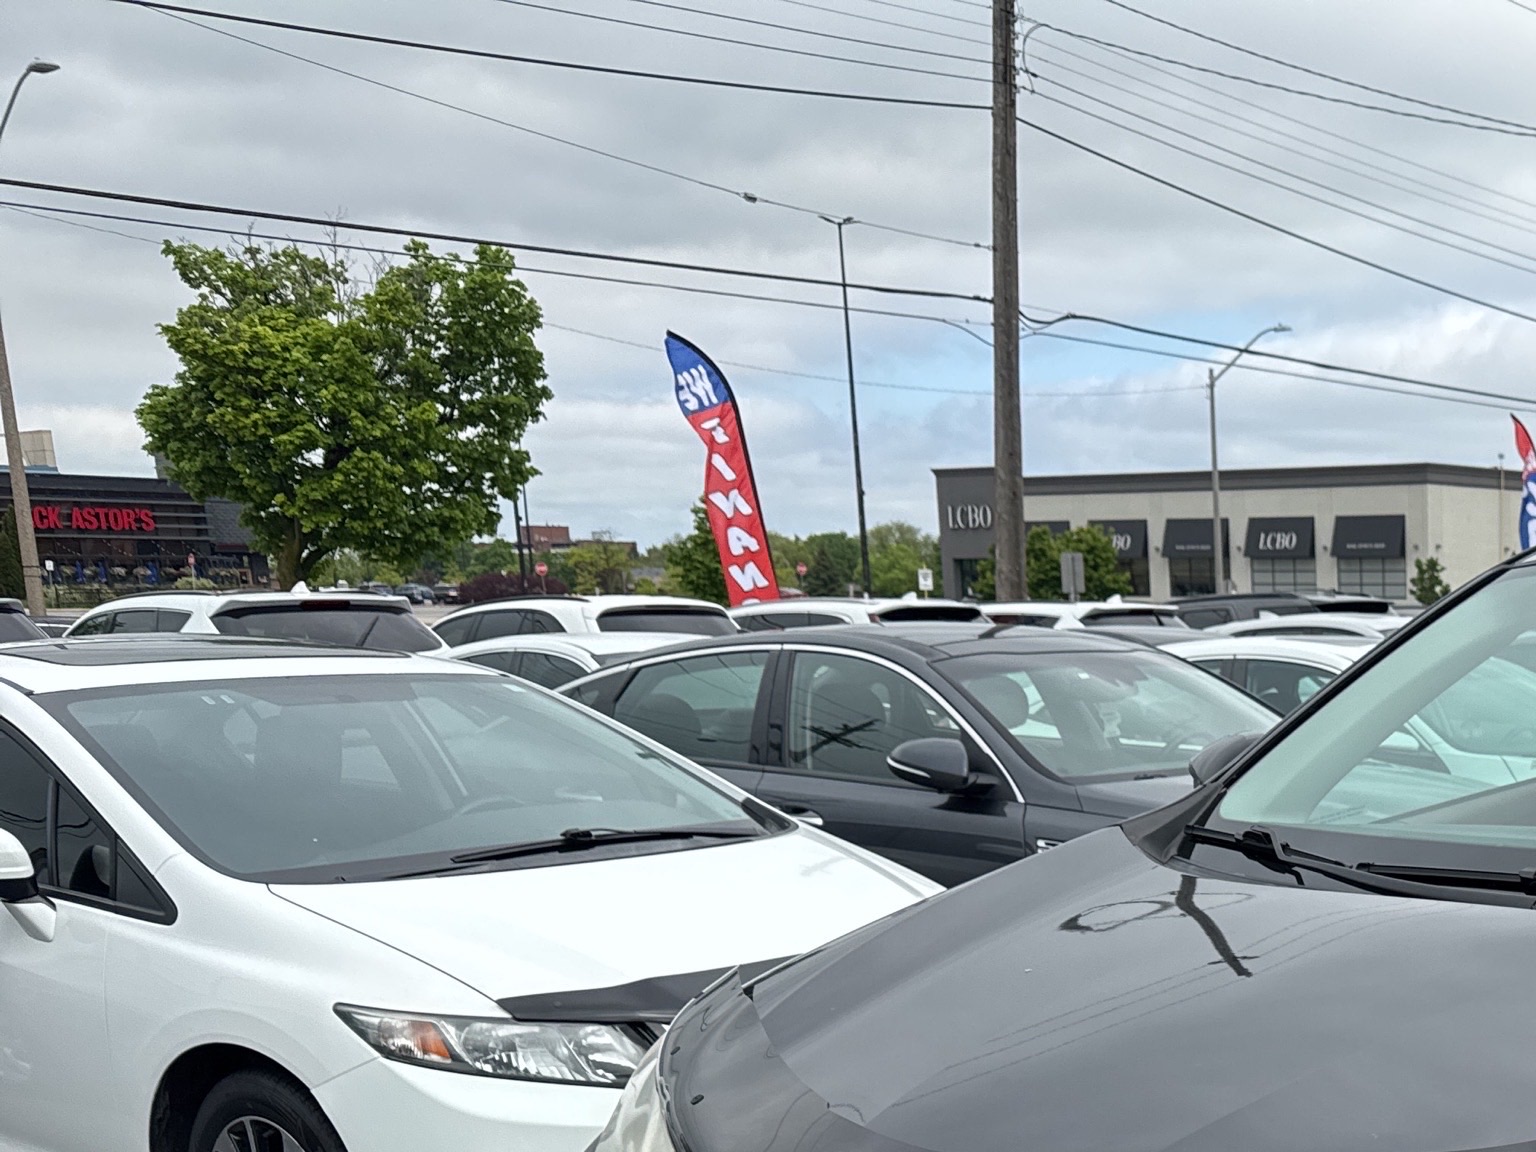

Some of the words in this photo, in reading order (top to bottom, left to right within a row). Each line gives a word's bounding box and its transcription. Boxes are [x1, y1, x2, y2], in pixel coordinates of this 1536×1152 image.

[32, 505, 63, 530] CK
[71, 507, 156, 532] ASTOR'S
[947, 504, 992, 530] LCBO
[1112, 534, 1132, 550] BO
[1258, 531, 1297, 550] LCBO
